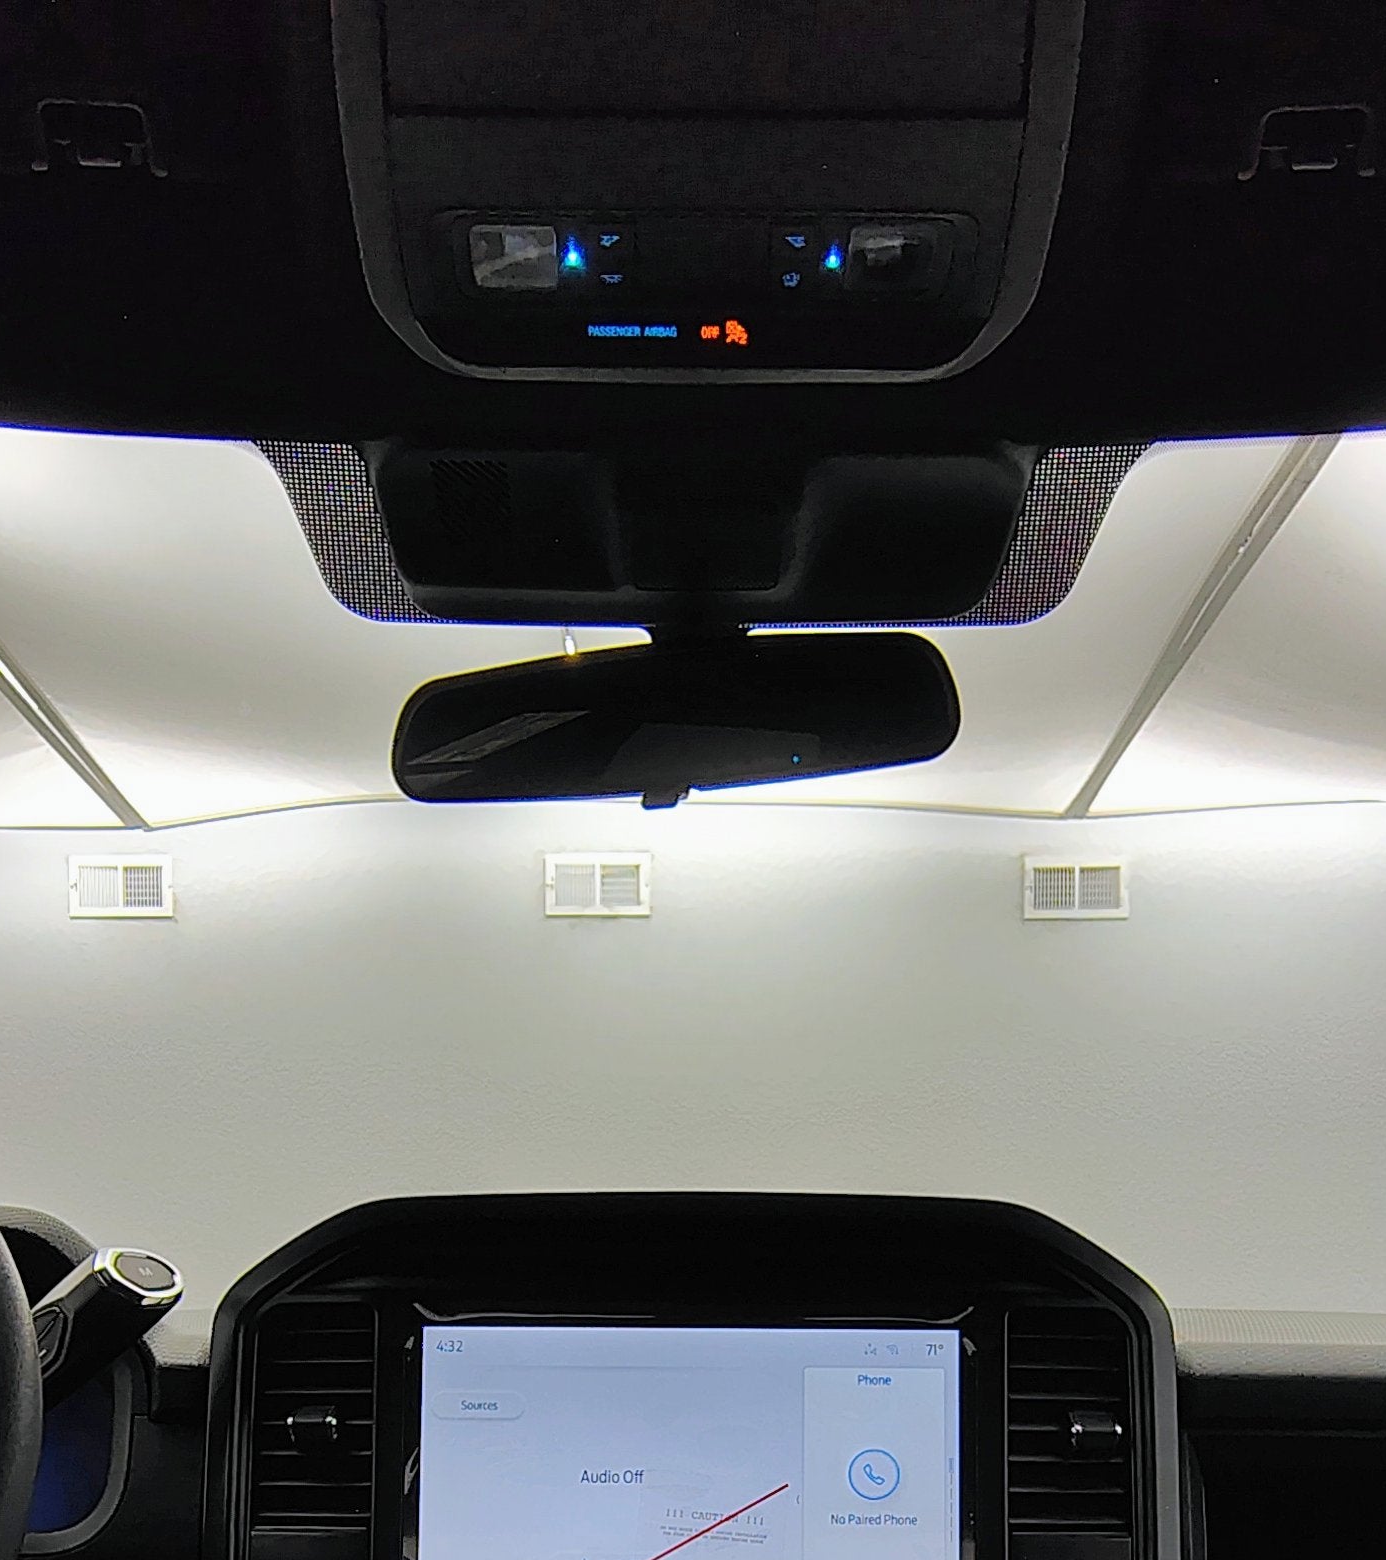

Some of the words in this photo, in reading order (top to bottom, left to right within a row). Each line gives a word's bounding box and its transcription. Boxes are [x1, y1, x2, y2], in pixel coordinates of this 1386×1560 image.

[587, 325, 641, 337] PASSENGER
[643, 325, 677, 338] AIRBAG
[700, 325, 720, 339] OFF
[436, 1340, 463, 1352] 4:32
[925, 1344, 944, 1356] 71°
[857, 1374, 892, 1386] Phone
[461, 1400, 498, 1411] Sources
[580, 1469, 620, 1484] Audio
[623, 1469, 645, 1484] Off
[692, 1511, 739, 1523] CAUTIN
[830, 1514, 846, 1526] No
[848, 1514, 881, 1526] Paired
[884, 1514, 918, 1526] Phone
